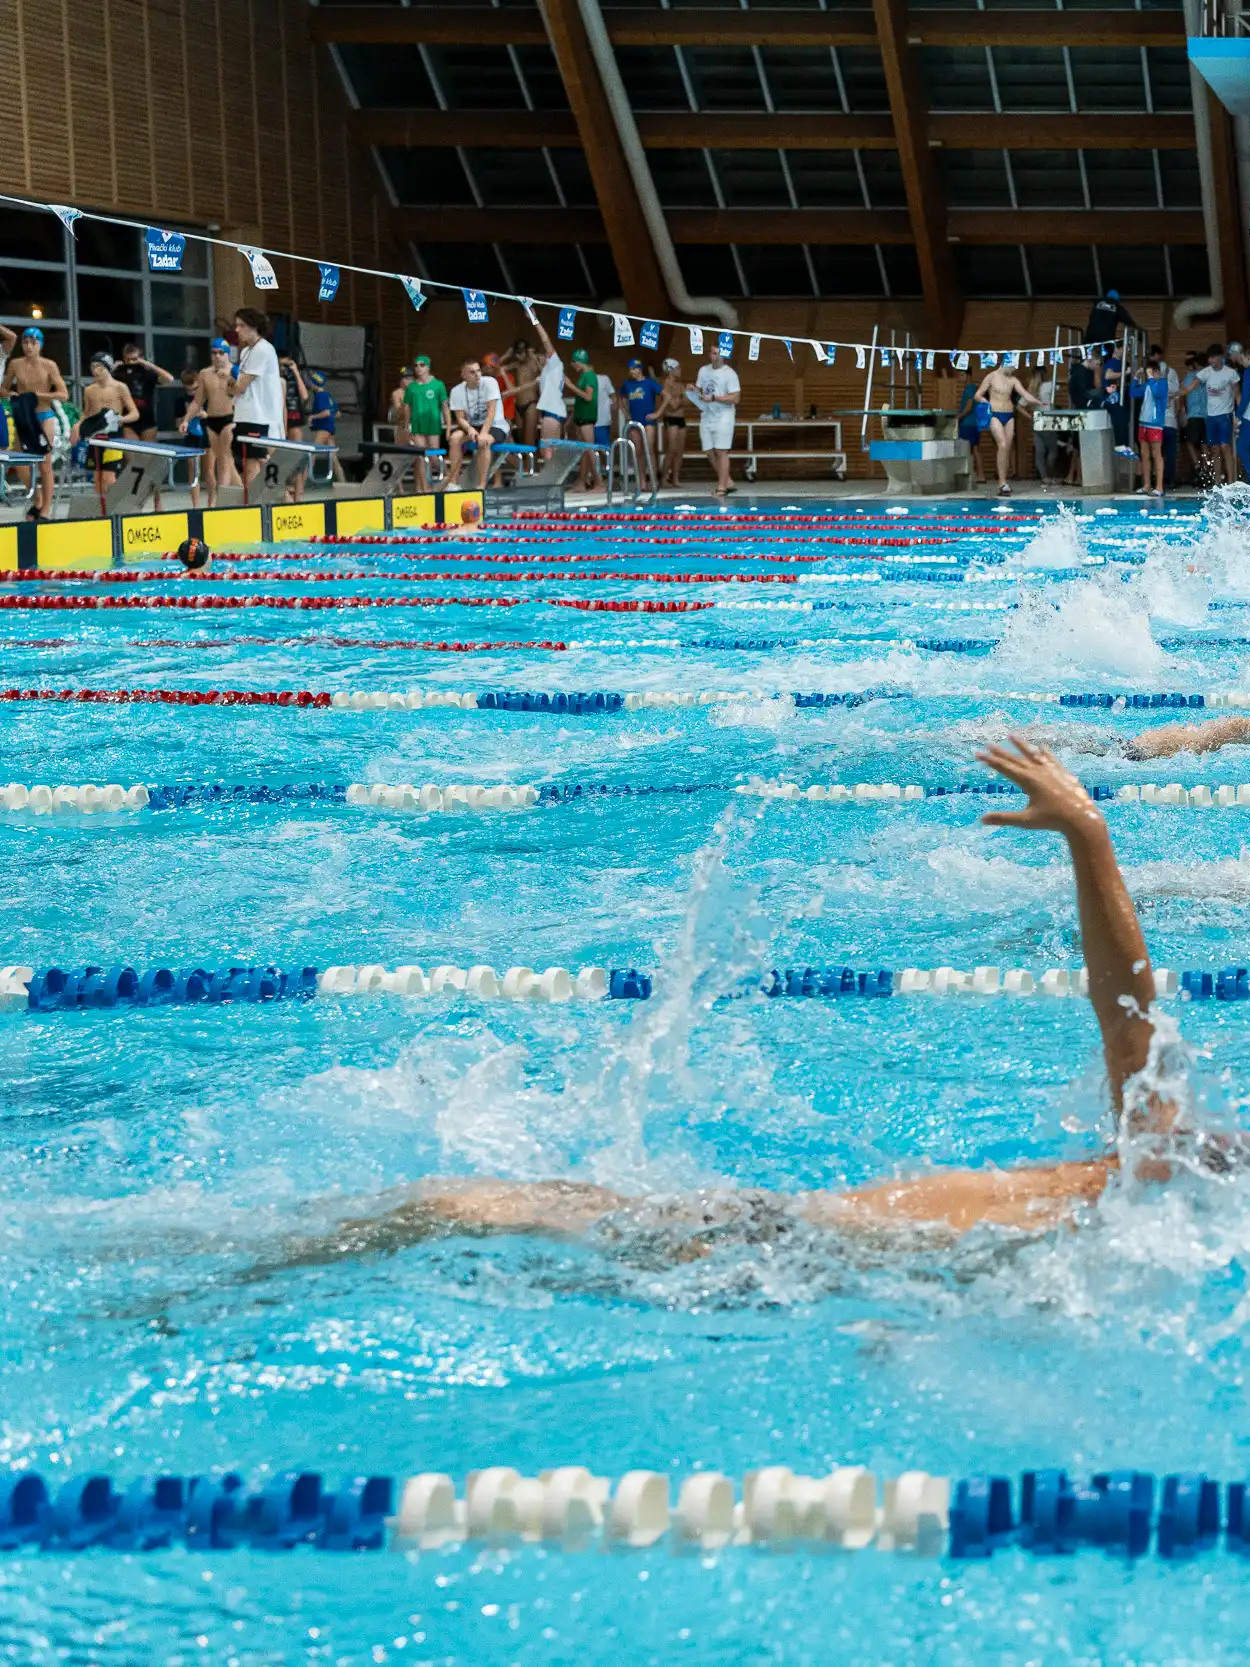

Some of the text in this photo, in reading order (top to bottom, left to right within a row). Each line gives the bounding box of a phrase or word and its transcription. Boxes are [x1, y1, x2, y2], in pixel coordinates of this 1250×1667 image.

[151, 254, 179, 267] Zadar
[255, 274, 273, 285] dar
[265, 463, 279, 488] 8
[379, 461, 393, 481] 9
[131, 466, 145, 495] 7
[396, 505, 419, 520] OMEGA
[276, 515, 304, 531] OMEGA
[127, 527, 162, 545] OMEGA
